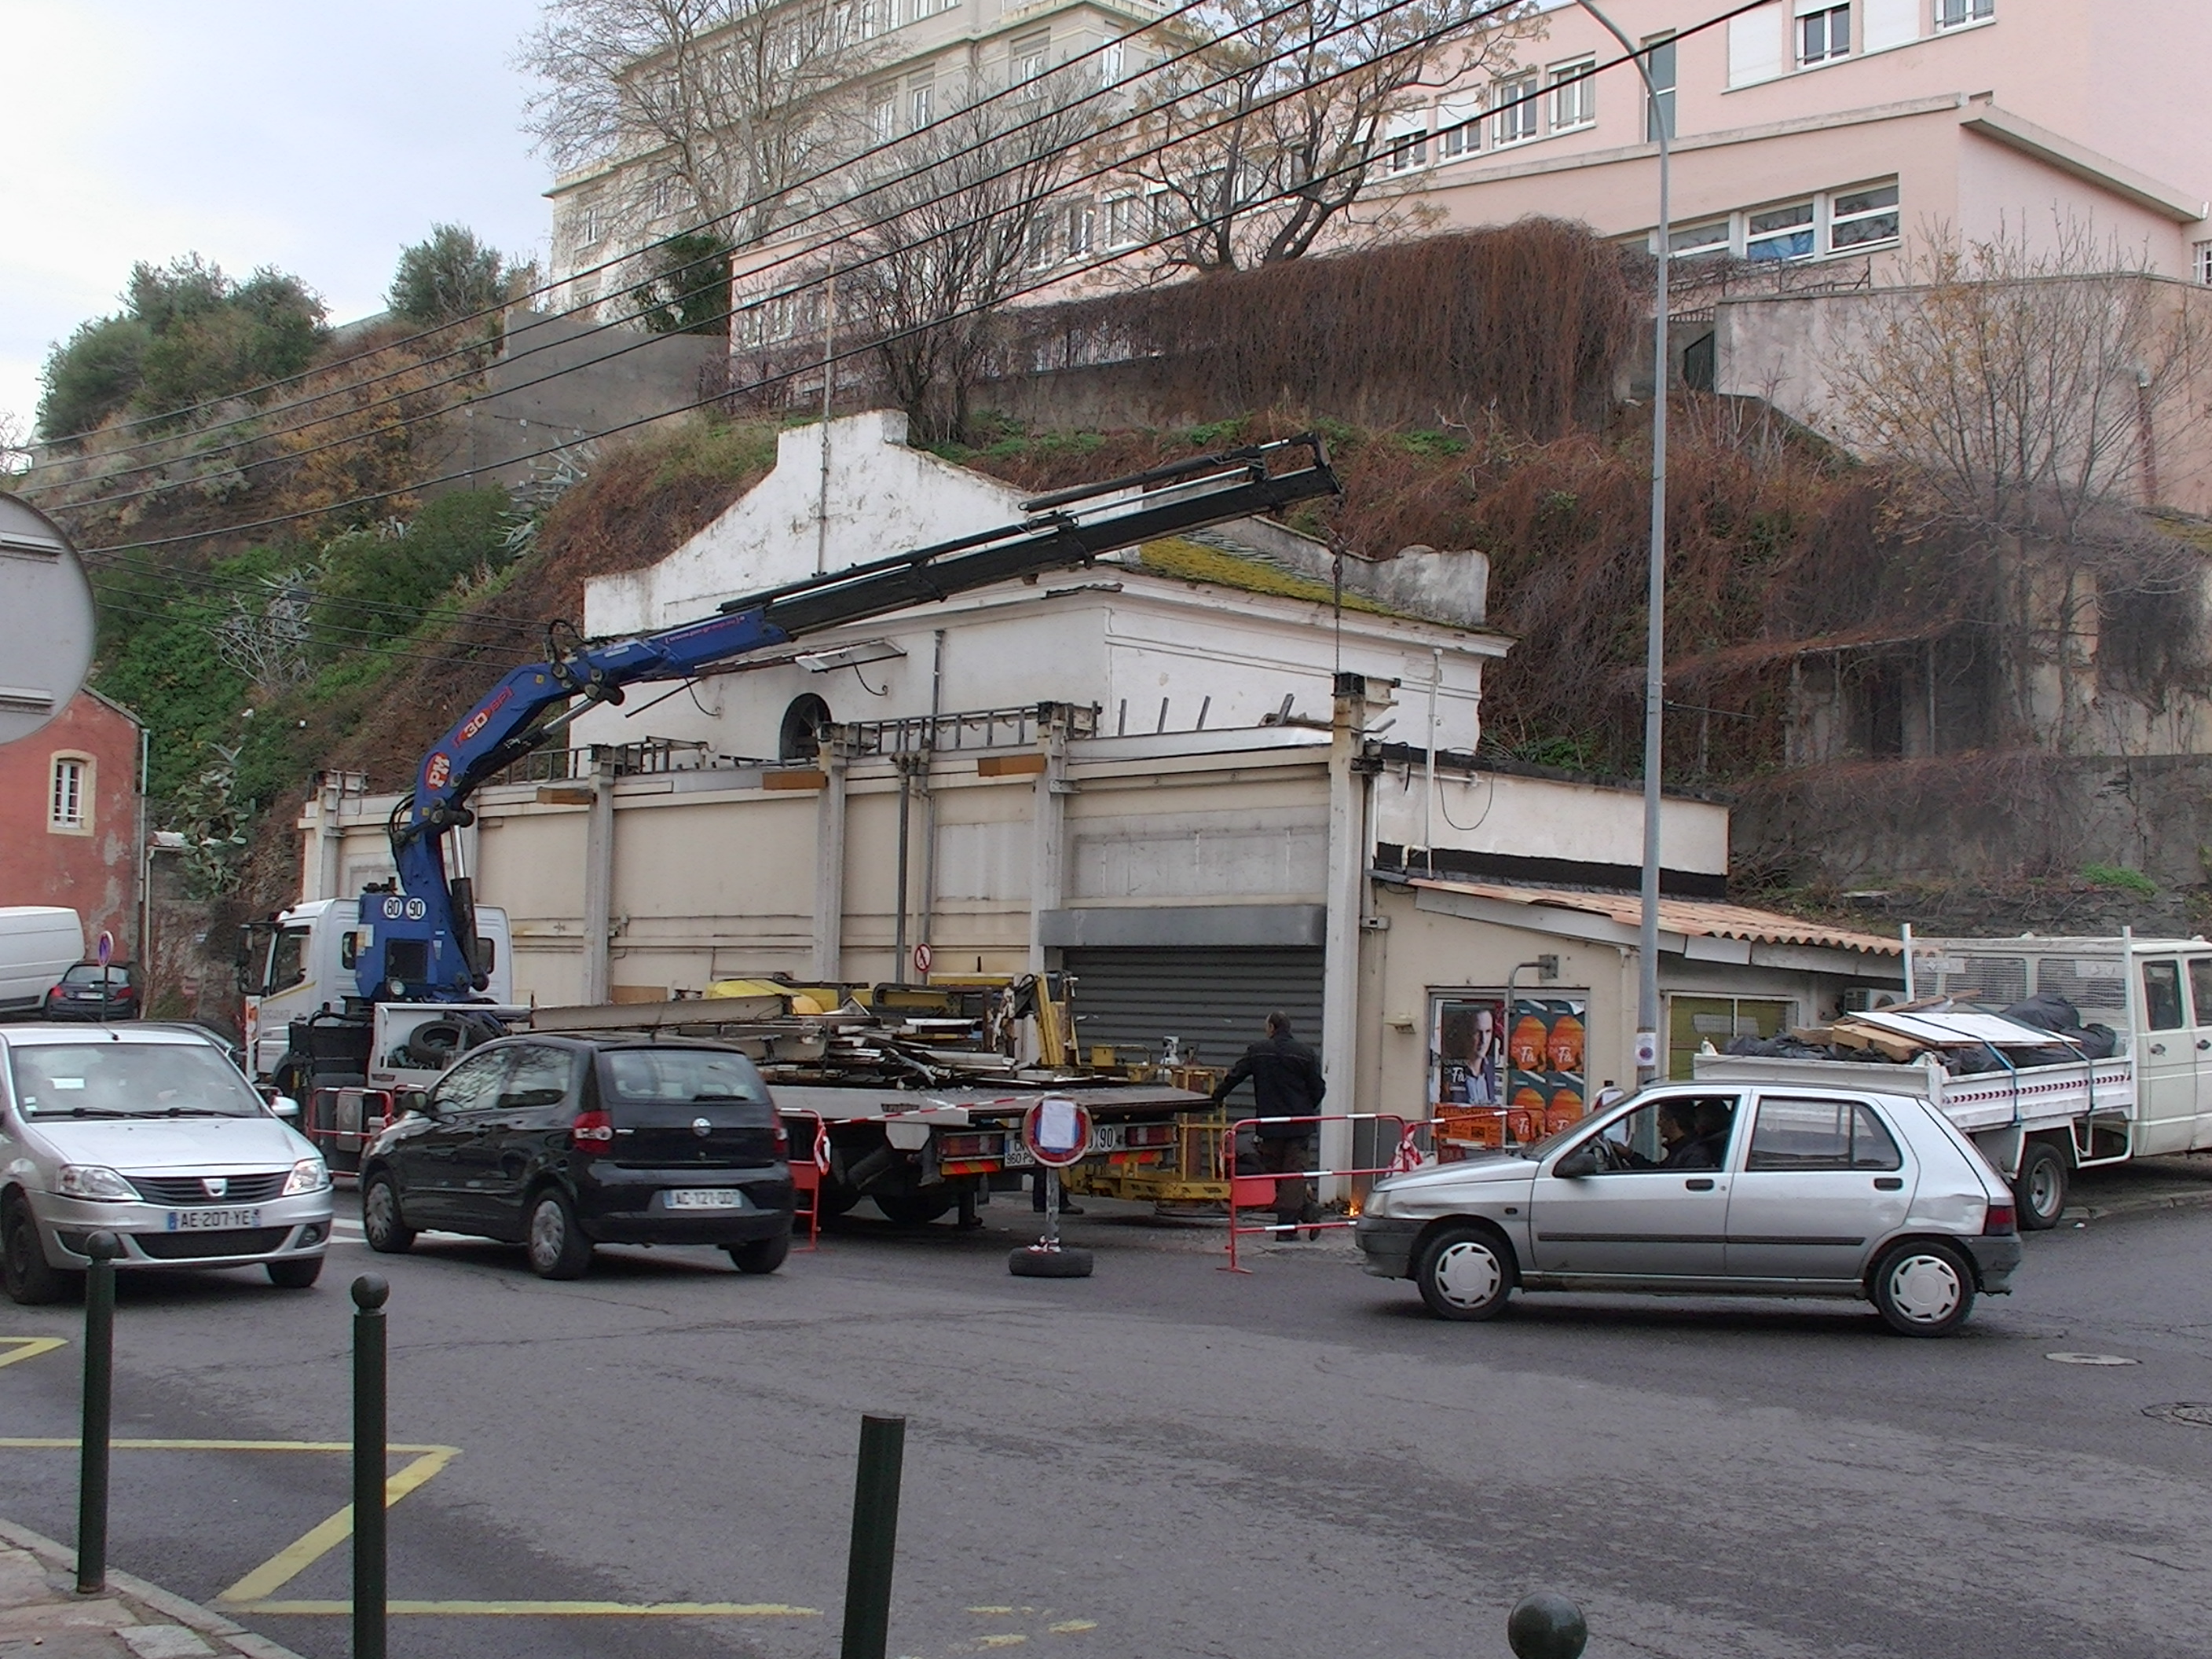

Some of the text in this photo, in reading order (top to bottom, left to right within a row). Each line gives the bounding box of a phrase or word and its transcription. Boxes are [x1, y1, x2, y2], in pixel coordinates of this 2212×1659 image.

[464, 712, 488, 738] 30
[428, 754, 451, 788] PM
[409, 900, 423, 917] 90
[1100, 1127, 1113, 1148] 90
[180, 1210, 250, 1228] AE-207-YE
